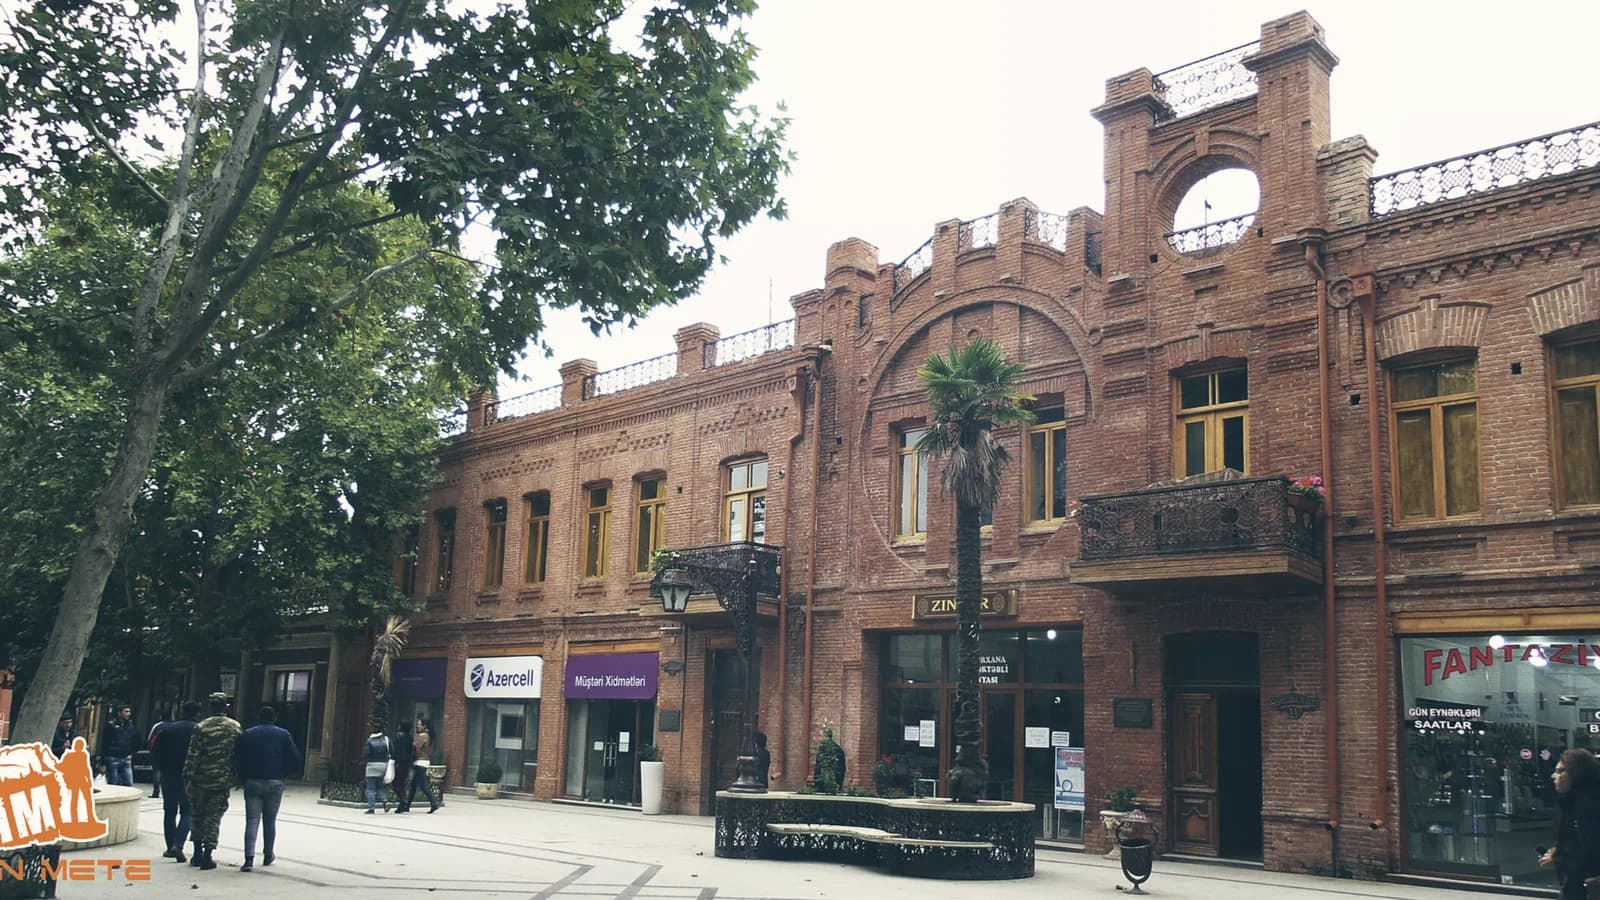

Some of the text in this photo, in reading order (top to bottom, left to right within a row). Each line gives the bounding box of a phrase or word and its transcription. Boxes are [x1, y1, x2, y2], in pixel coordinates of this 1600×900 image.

[931, 597, 990, 612] ZINR
[979, 656, 1007, 664] RXANA
[979, 664, 1009, 673] KTƏBLİ
[486, 669, 534, 687] Azercell
[575, 674, 647, 690] Müştəri Xidmətləri
[1408, 707, 1481, 718] GÜN EYNƏKLƏRİ
[1414, 720, 1472, 730] SAATLAR
